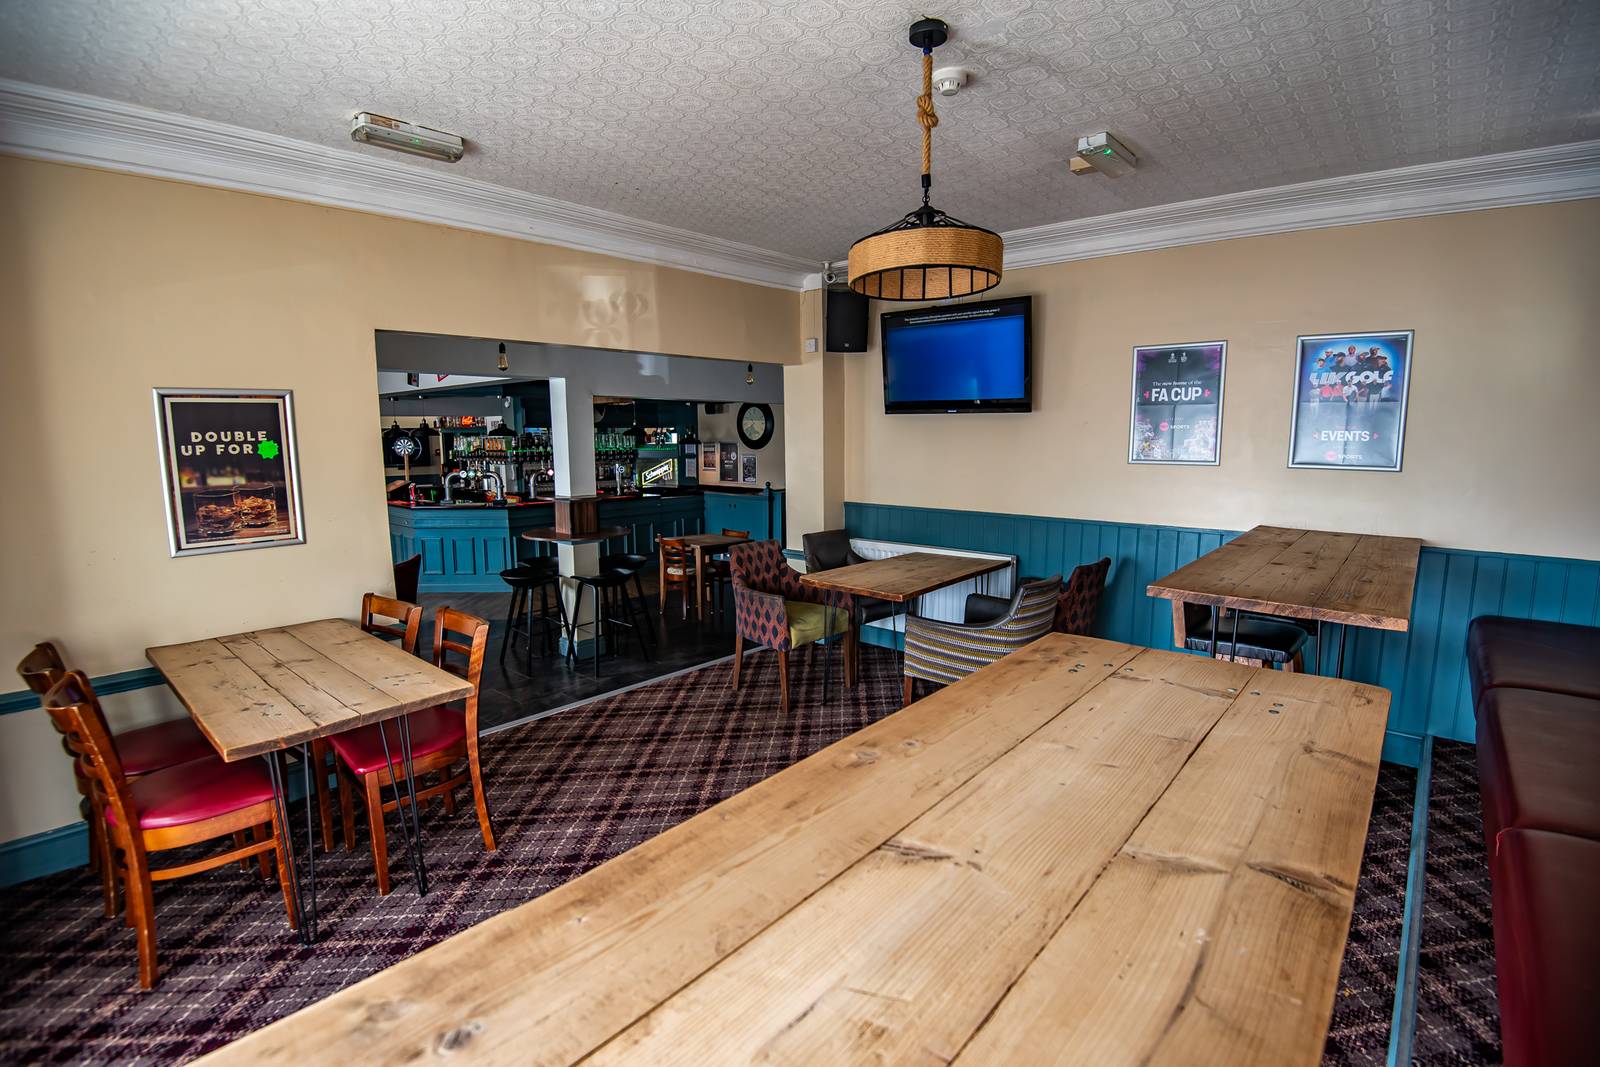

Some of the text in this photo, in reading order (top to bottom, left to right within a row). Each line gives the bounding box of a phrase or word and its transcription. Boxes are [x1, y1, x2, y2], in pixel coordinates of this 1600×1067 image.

[1151, 387, 1202, 402] FA CUP
[190, 431, 267, 442] DOUBLE
[1321, 430, 1370, 442] EVENTS
[180, 443, 254, 456] UP FOR
